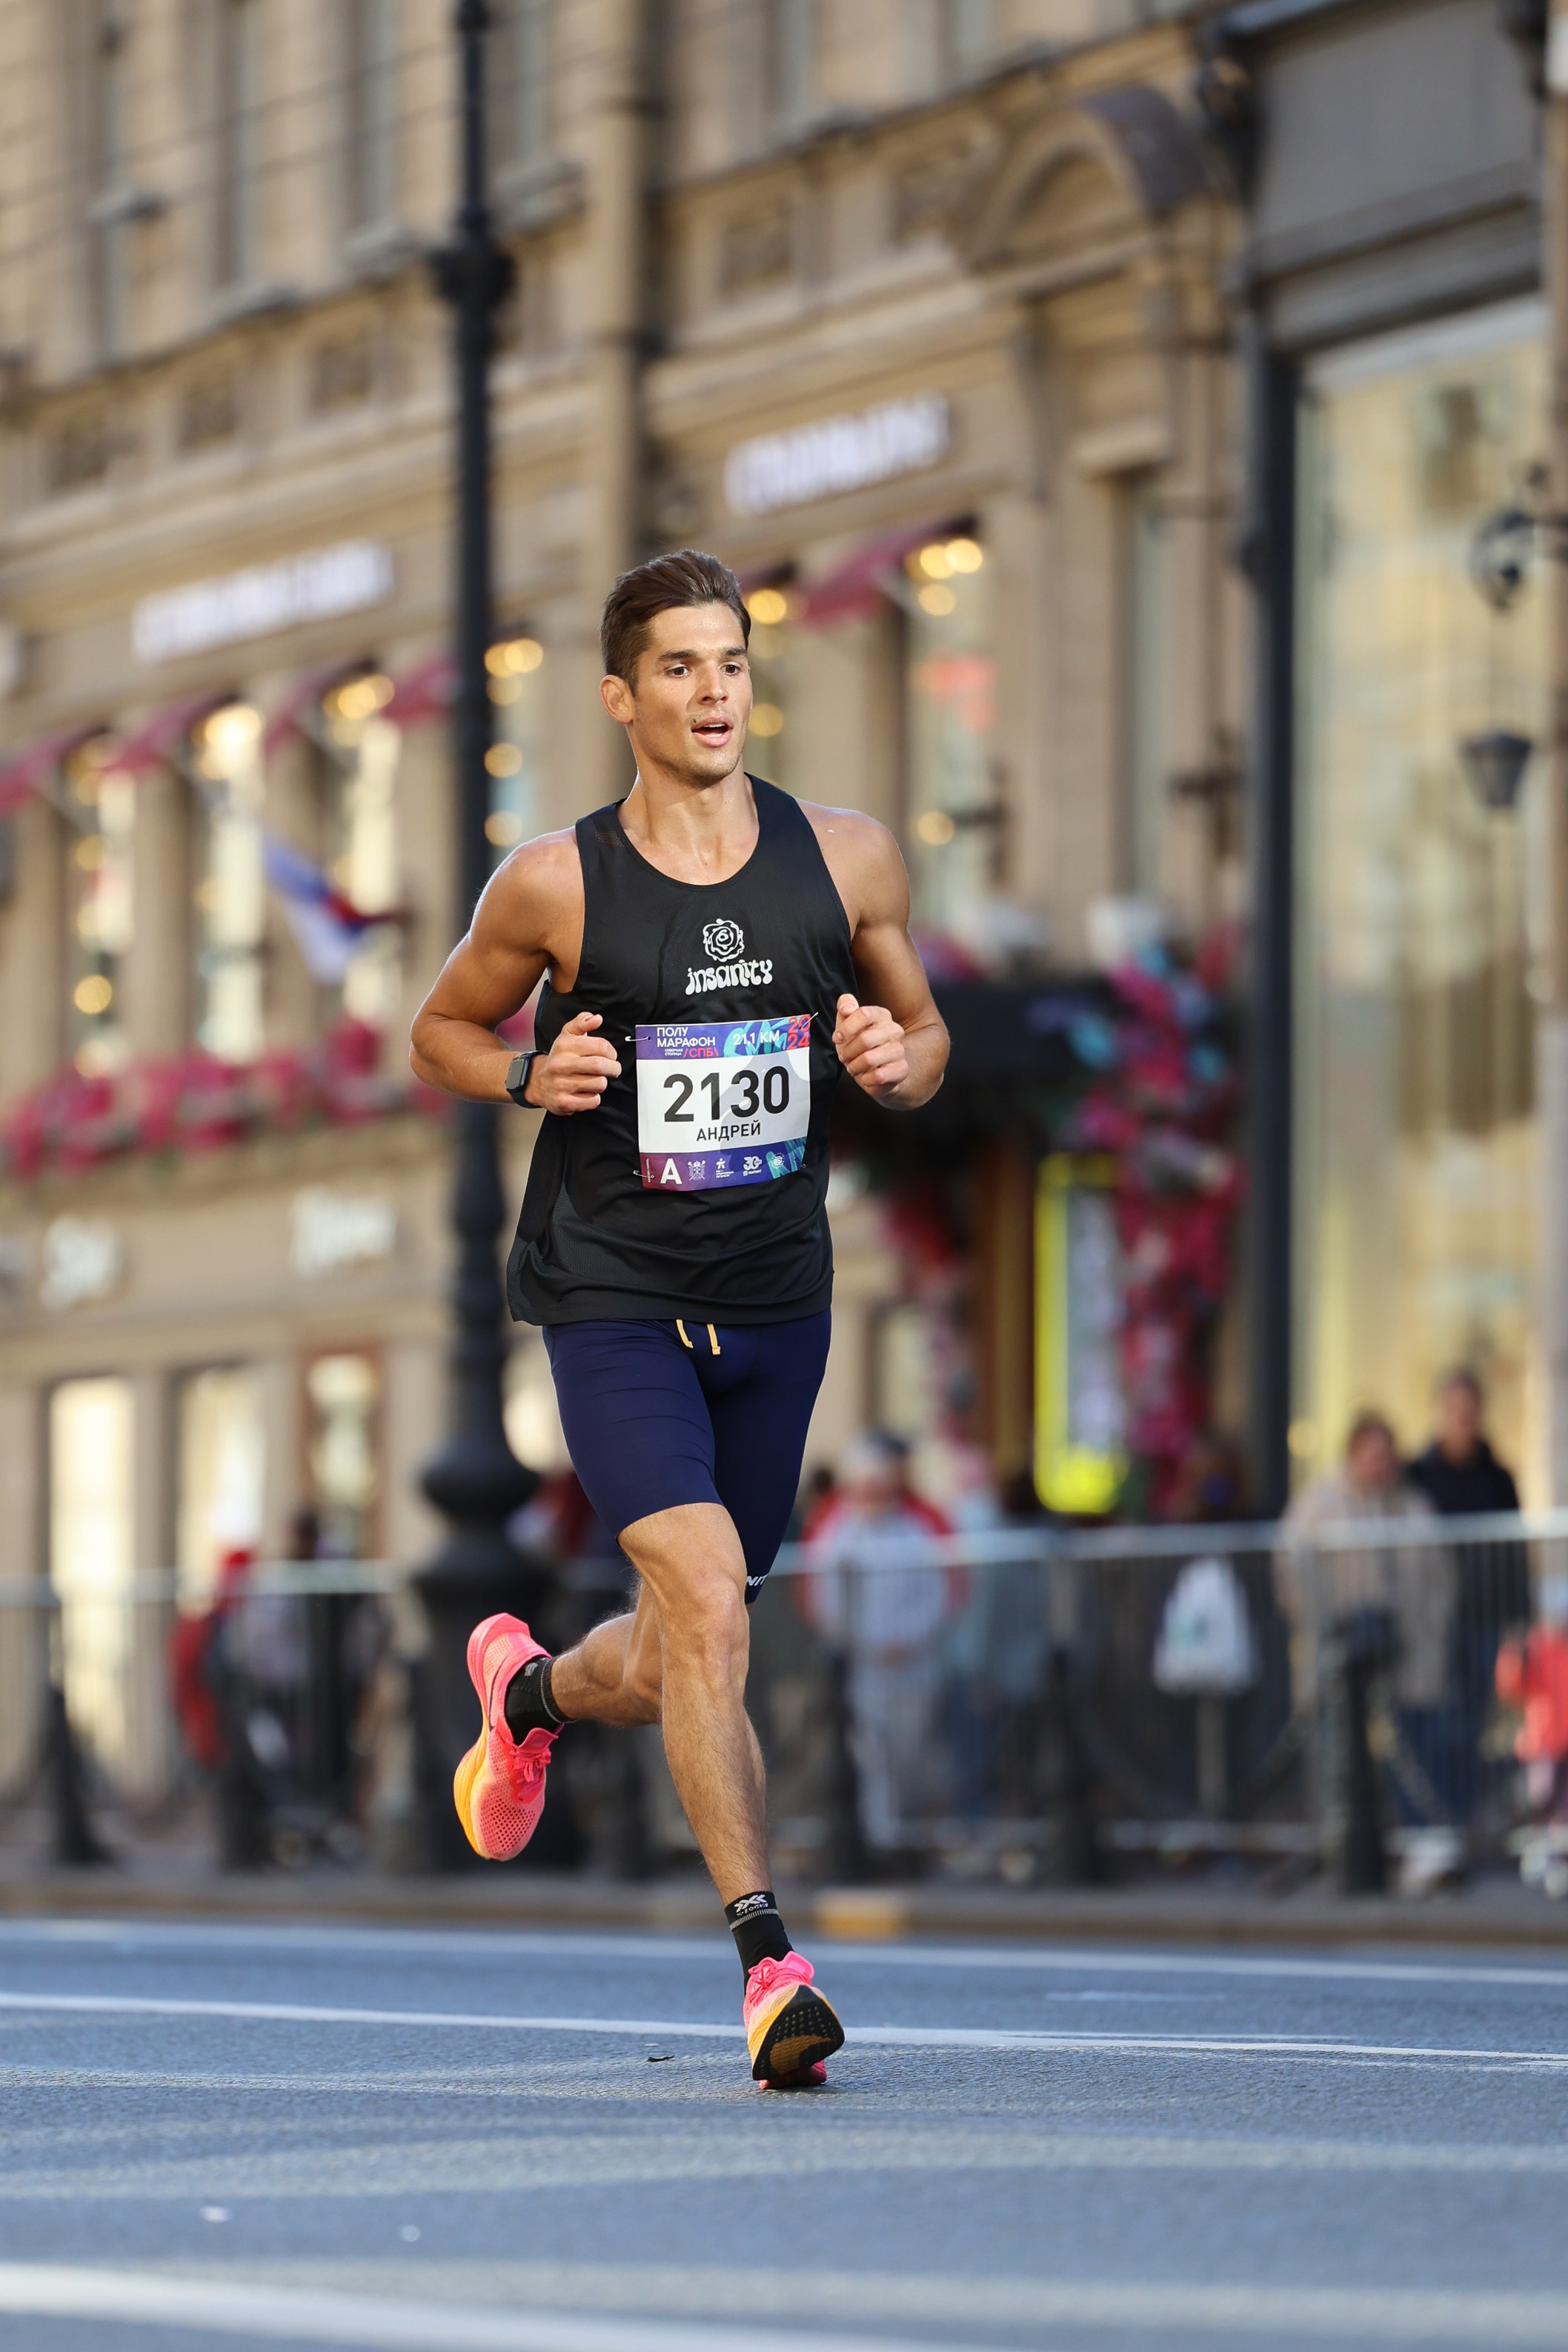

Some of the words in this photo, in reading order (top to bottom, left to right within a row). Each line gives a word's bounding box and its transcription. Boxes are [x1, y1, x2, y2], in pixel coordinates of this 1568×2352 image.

[685, 959, 773, 995] insanity
[657, 1026, 688, 1037] ПОЛУ
[788, 1014, 811, 1034] 20
[657, 1037, 716, 1048] МАРАФОН
[787, 1032, 810, 1050] 24
[663, 1066, 789, 1123] 2130
[697, 1120, 761, 1141] АНДРЕЙ
